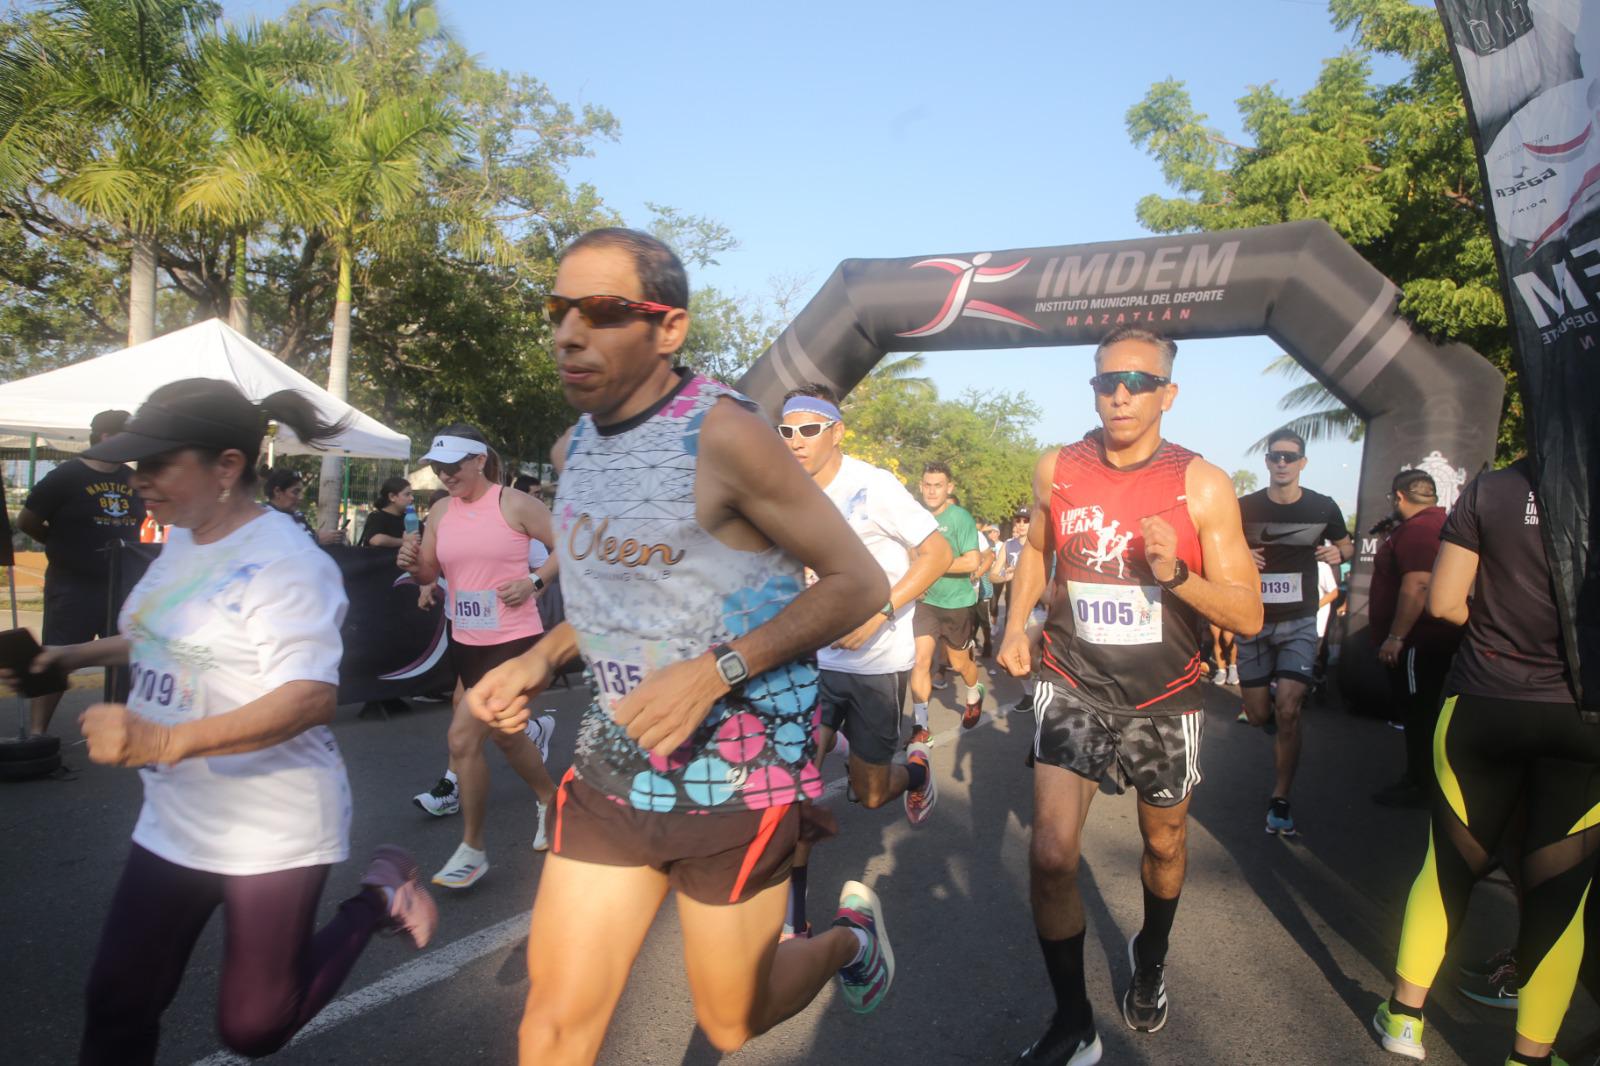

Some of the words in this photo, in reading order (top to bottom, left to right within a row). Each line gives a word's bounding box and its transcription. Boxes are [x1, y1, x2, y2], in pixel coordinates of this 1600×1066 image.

[1036, 241, 1241, 299] IMDEM
[1035, 299, 1088, 313] INSTITUTO
[1090, 295, 1149, 309] MUNICIPAL
[1151, 293, 1171, 305] DEL
[1173, 289, 1225, 303] DEPORTE
[1066, 308, 1191, 326] MAZATLÁN
[85, 482, 133, 496] NAUTICA
[1061, 518, 1100, 535] TEAM
[455, 600, 480, 617] 150
[1077, 599, 1134, 626] 0105
